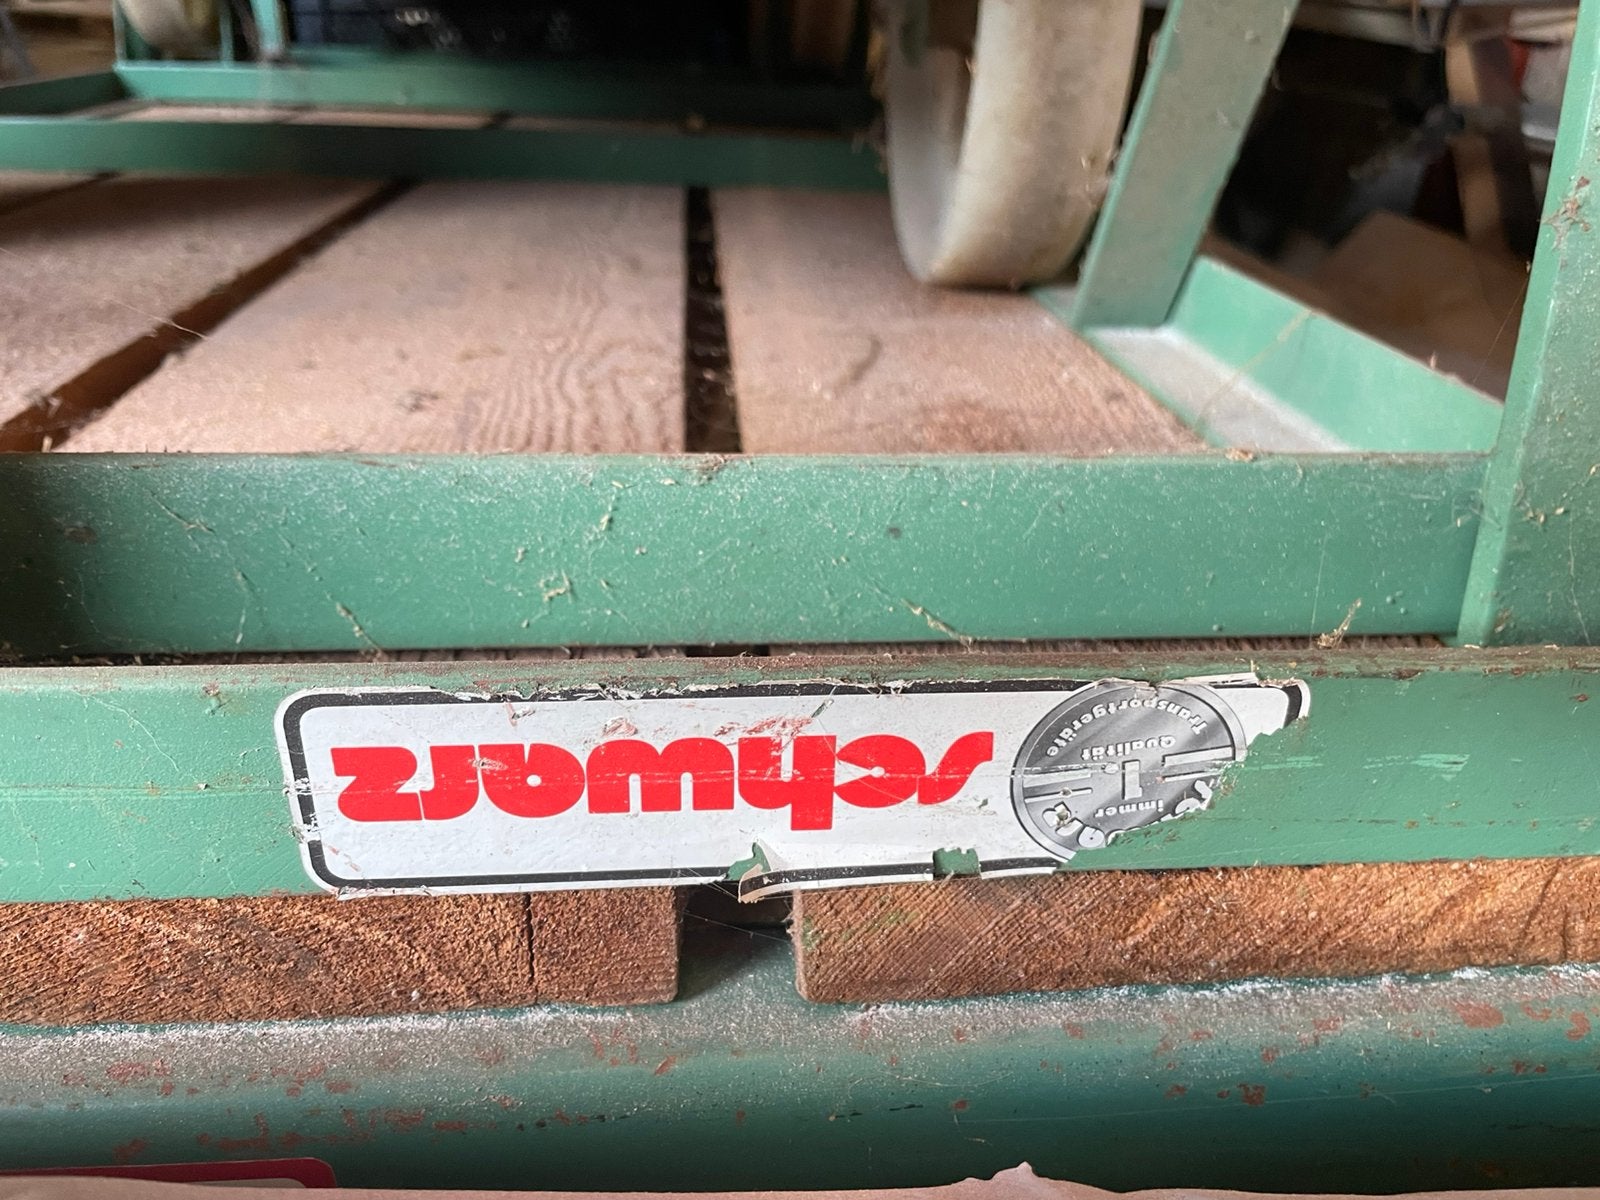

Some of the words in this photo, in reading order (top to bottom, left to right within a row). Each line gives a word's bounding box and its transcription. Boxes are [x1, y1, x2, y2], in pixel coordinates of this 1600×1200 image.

[1046, 698, 1208, 757] Transportgeräte
[1082, 735, 1176, 761] Qualität
[332, 732, 993, 830] schwarz
[1095, 800, 1165, 818] immer
